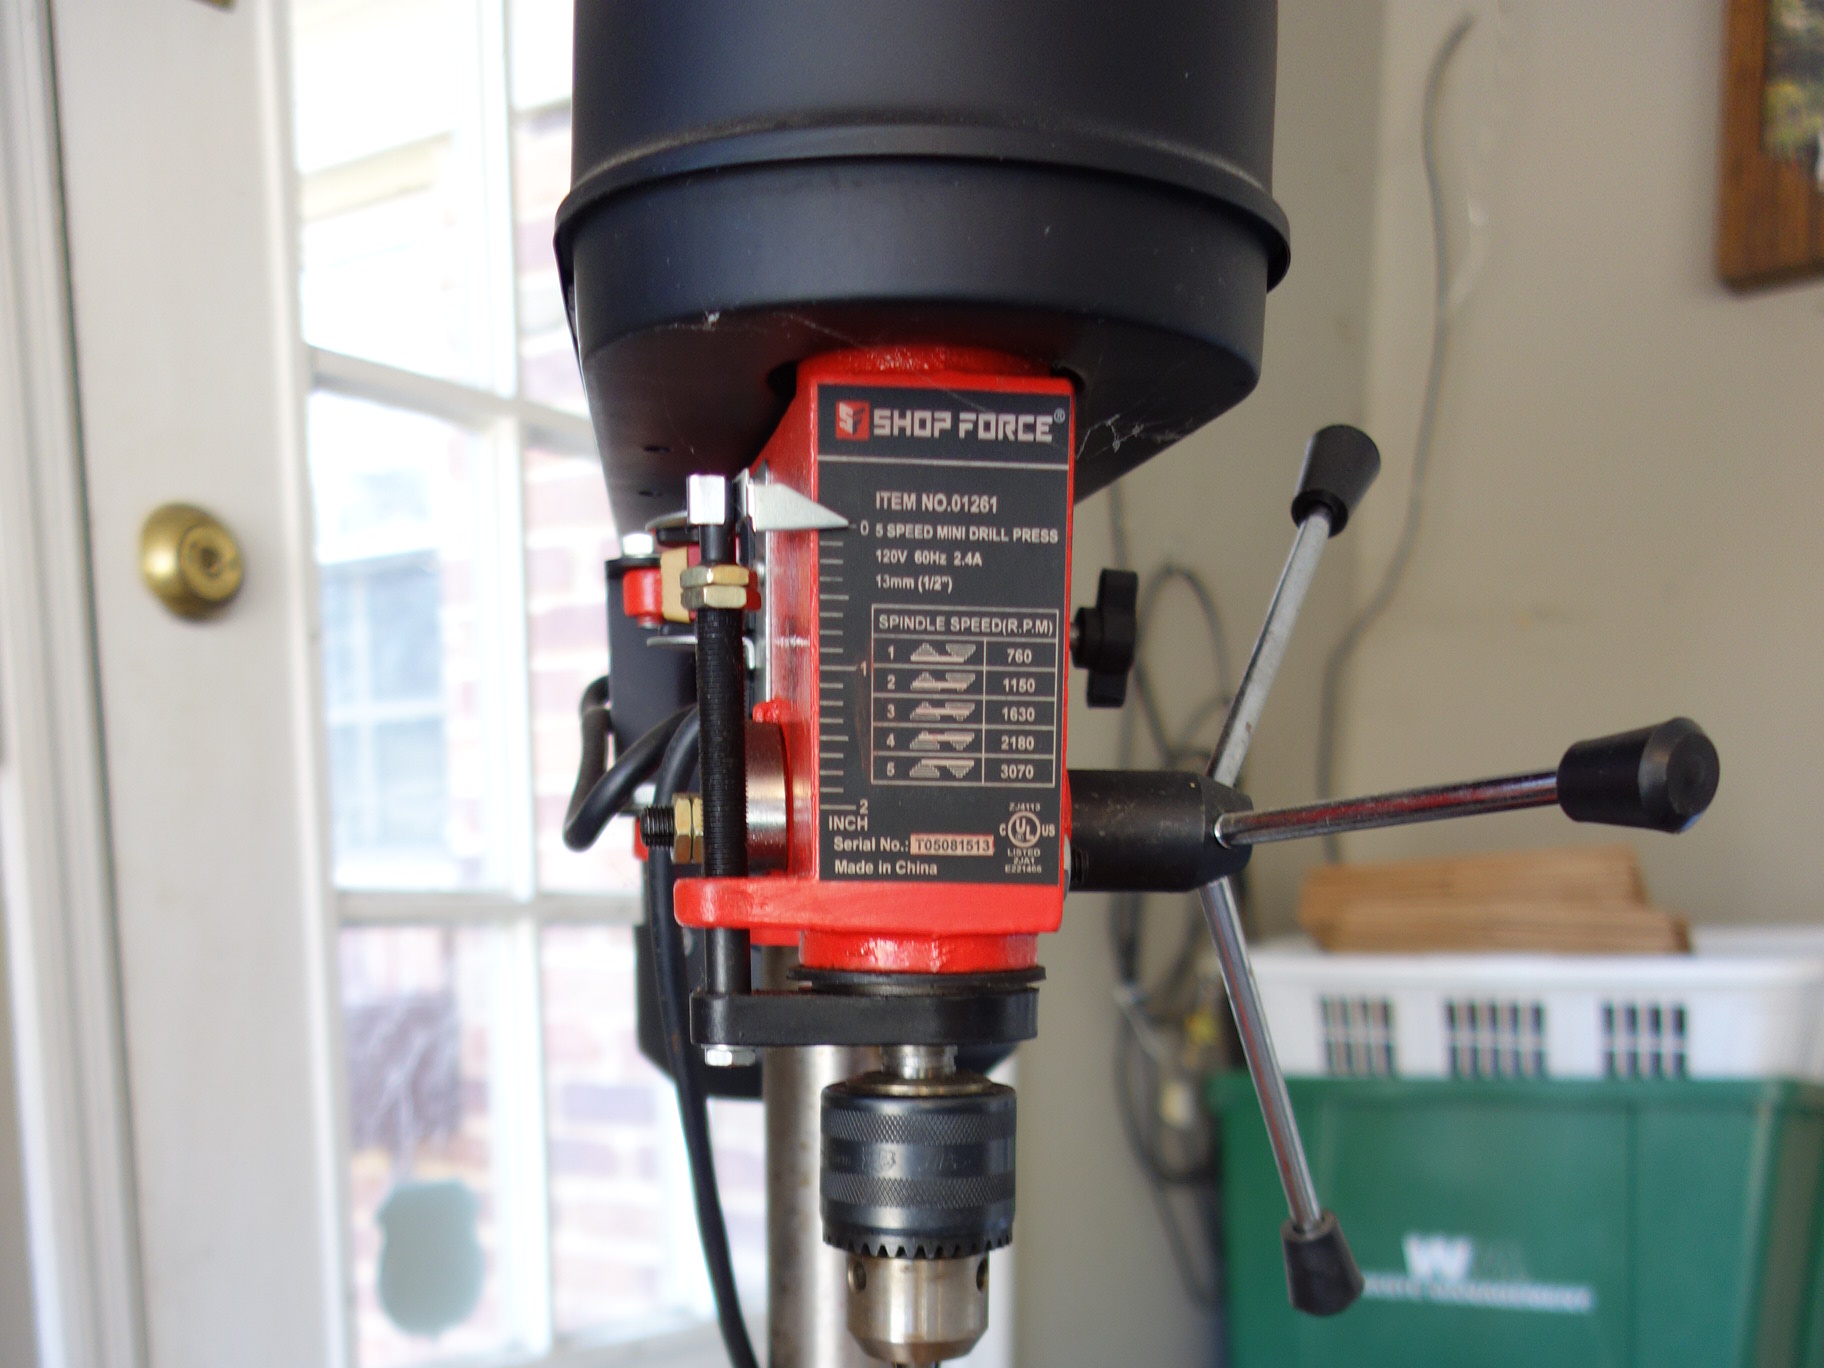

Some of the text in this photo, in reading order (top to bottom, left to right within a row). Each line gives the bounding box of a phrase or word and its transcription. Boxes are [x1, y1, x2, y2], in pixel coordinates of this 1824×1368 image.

[873, 409, 952, 438] SHOP
[875, 491, 998, 515] ITEM NO.01261
[875, 523, 1059, 545] 5 SPEED MINI DRILL PRESS
[875, 549, 983, 567] 120V 60Hz 2.4A
[875, 574, 953, 594] 13mm (1/2")
[879, 614, 1053, 636] SPINDLE SPEED(R.P.M)
[887, 646, 895, 660] 1
[1006, 648, 1033, 664] 760
[887, 675, 896, 690] 2
[1002, 677, 1036, 693] 1150
[887, 704, 895, 719] 3
[1002, 706, 1035, 722] 1630
[886, 733, 895, 748] 4
[1001, 735, 1035, 751] 2180
[886, 761, 895, 777] 5
[1000, 764, 1034, 780] 3070
[860, 798, 869, 815] 2
[828, 815, 868, 832] INCH
[1041, 823, 1056, 838] US
[833, 835, 990, 853] Serial No.: T05081513
[1007, 848, 1041, 858] LISTED
[834, 858, 938, 876] Made in China
